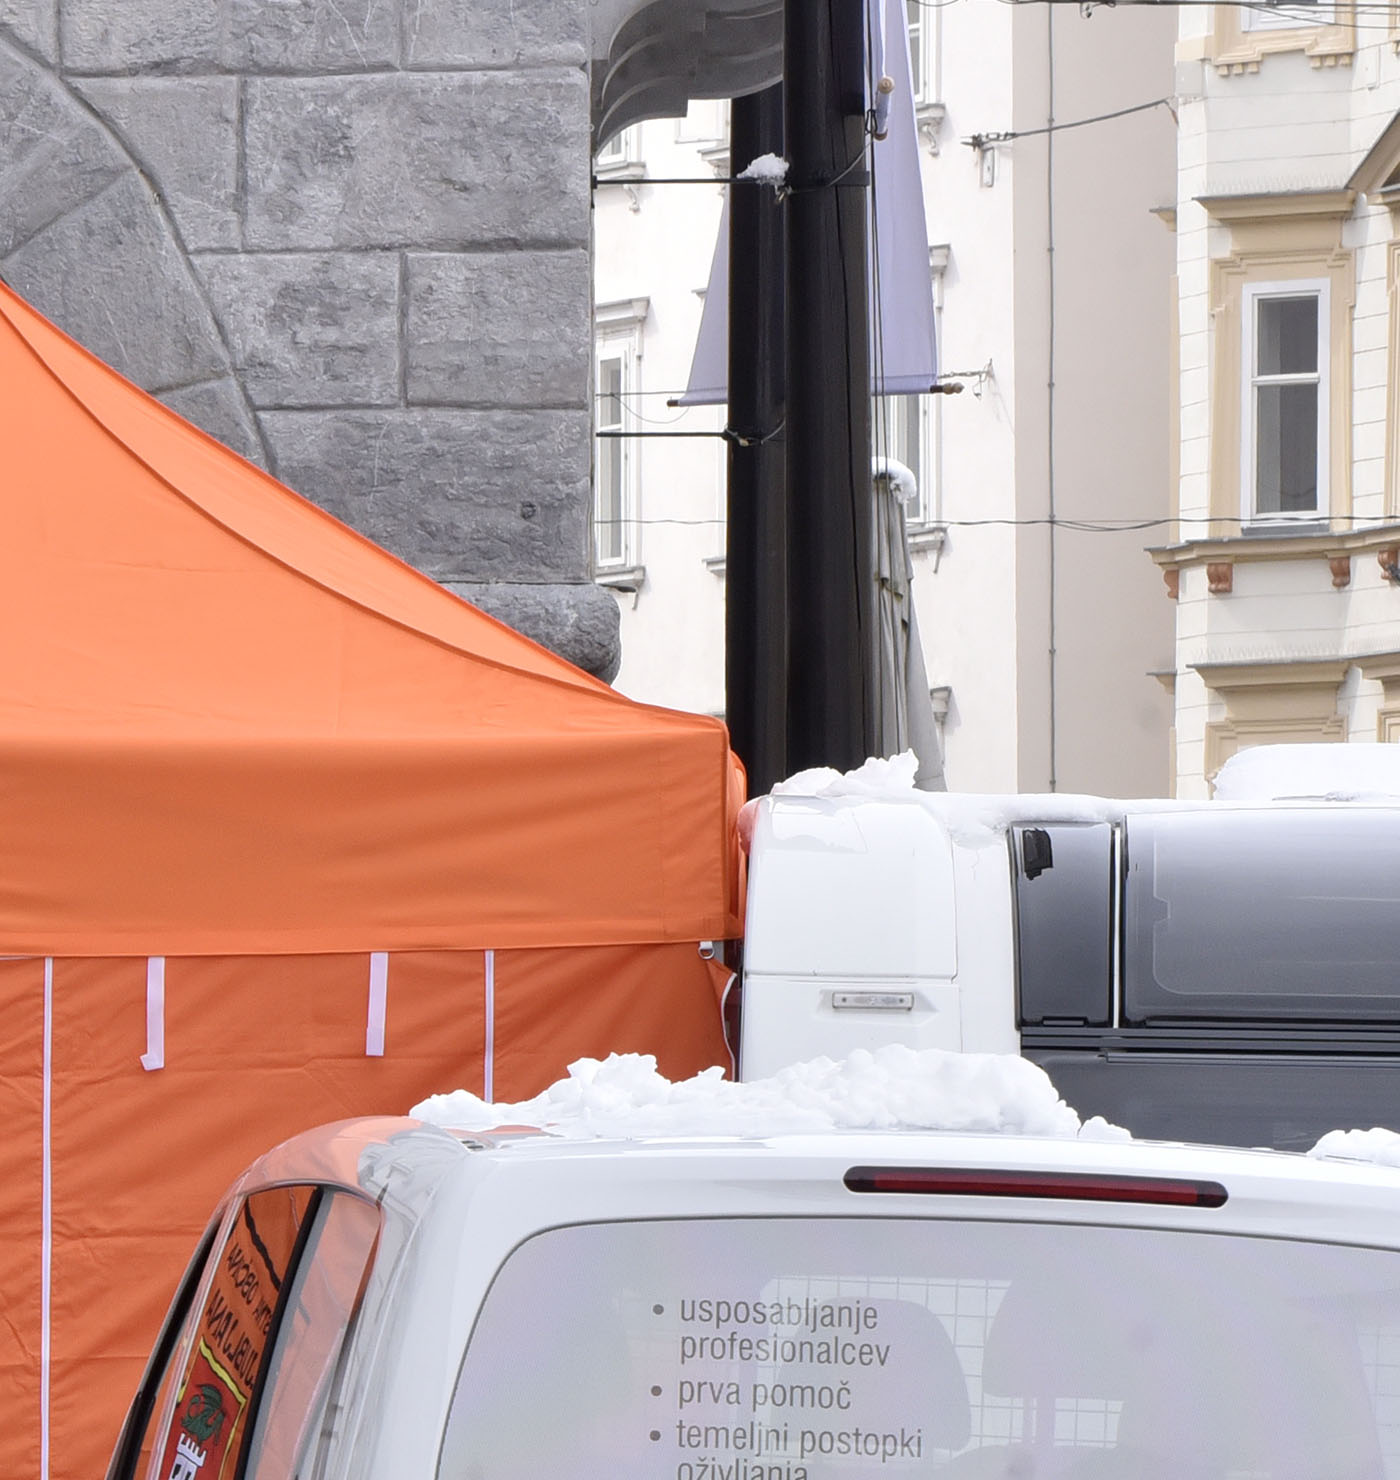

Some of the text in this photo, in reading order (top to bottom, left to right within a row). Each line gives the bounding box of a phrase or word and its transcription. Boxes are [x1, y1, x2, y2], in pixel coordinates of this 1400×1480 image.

[680, 1296, 879, 1335] usposabljanje
[680, 1332, 891, 1367] profesionalcev
[678, 1379, 852, 1412] prva pomoč
[676, 1420, 923, 1463] temeljni postopki
